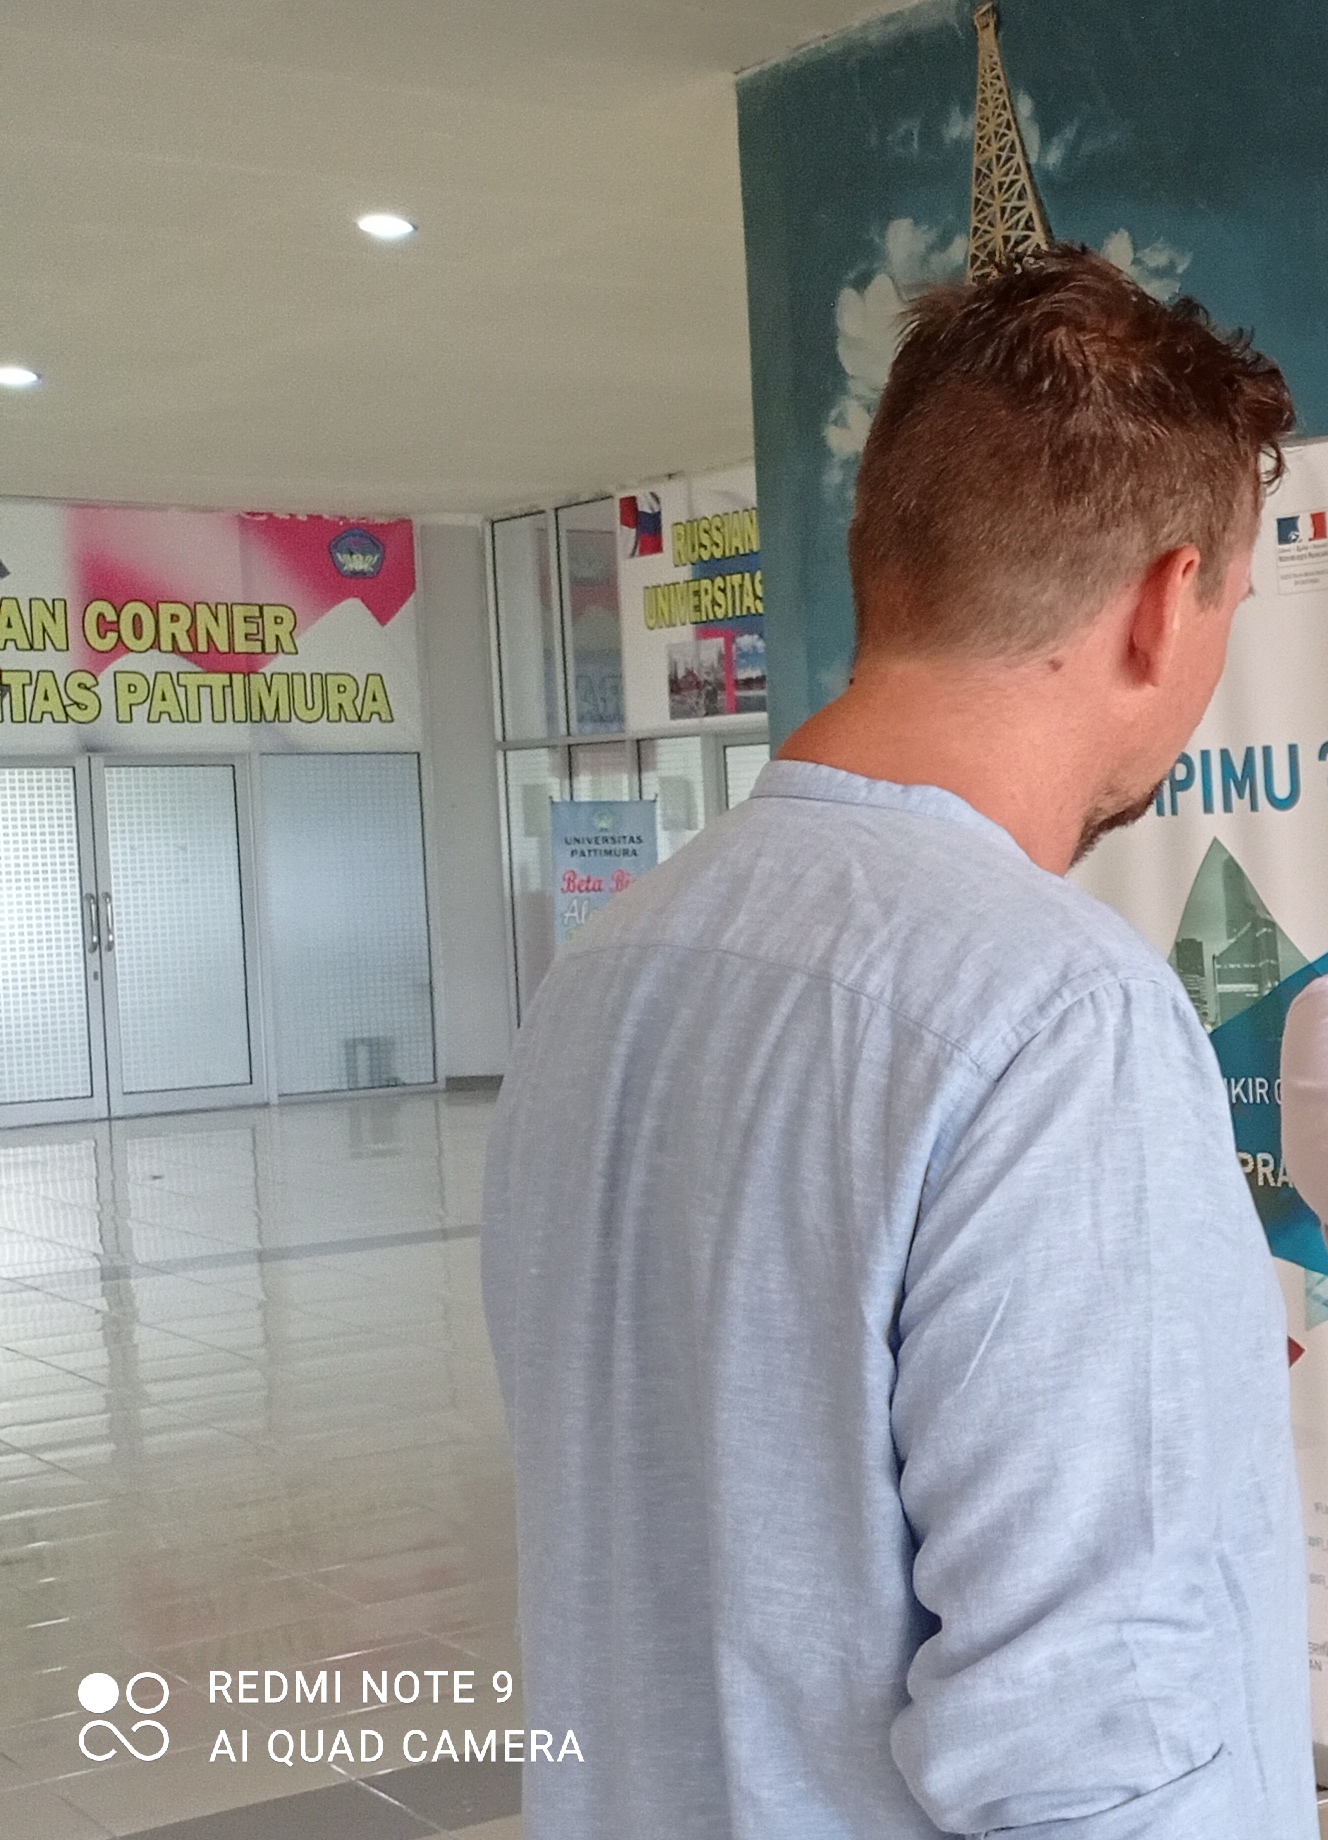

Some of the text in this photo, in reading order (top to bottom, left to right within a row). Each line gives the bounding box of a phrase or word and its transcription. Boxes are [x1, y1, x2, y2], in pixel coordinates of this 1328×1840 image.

[671, 507, 760, 568] RUSSIAN
[0, 597, 298, 655] AN CORNER
[643, 570, 764, 631] UNIVERSITAS
[0, 669, 394, 725] TAS PATTIMURA
[564, 835, 644, 846] UNIVERSITAS
[570, 848, 639, 858] PATTIMURA
[561, 869, 604, 893] Beta
